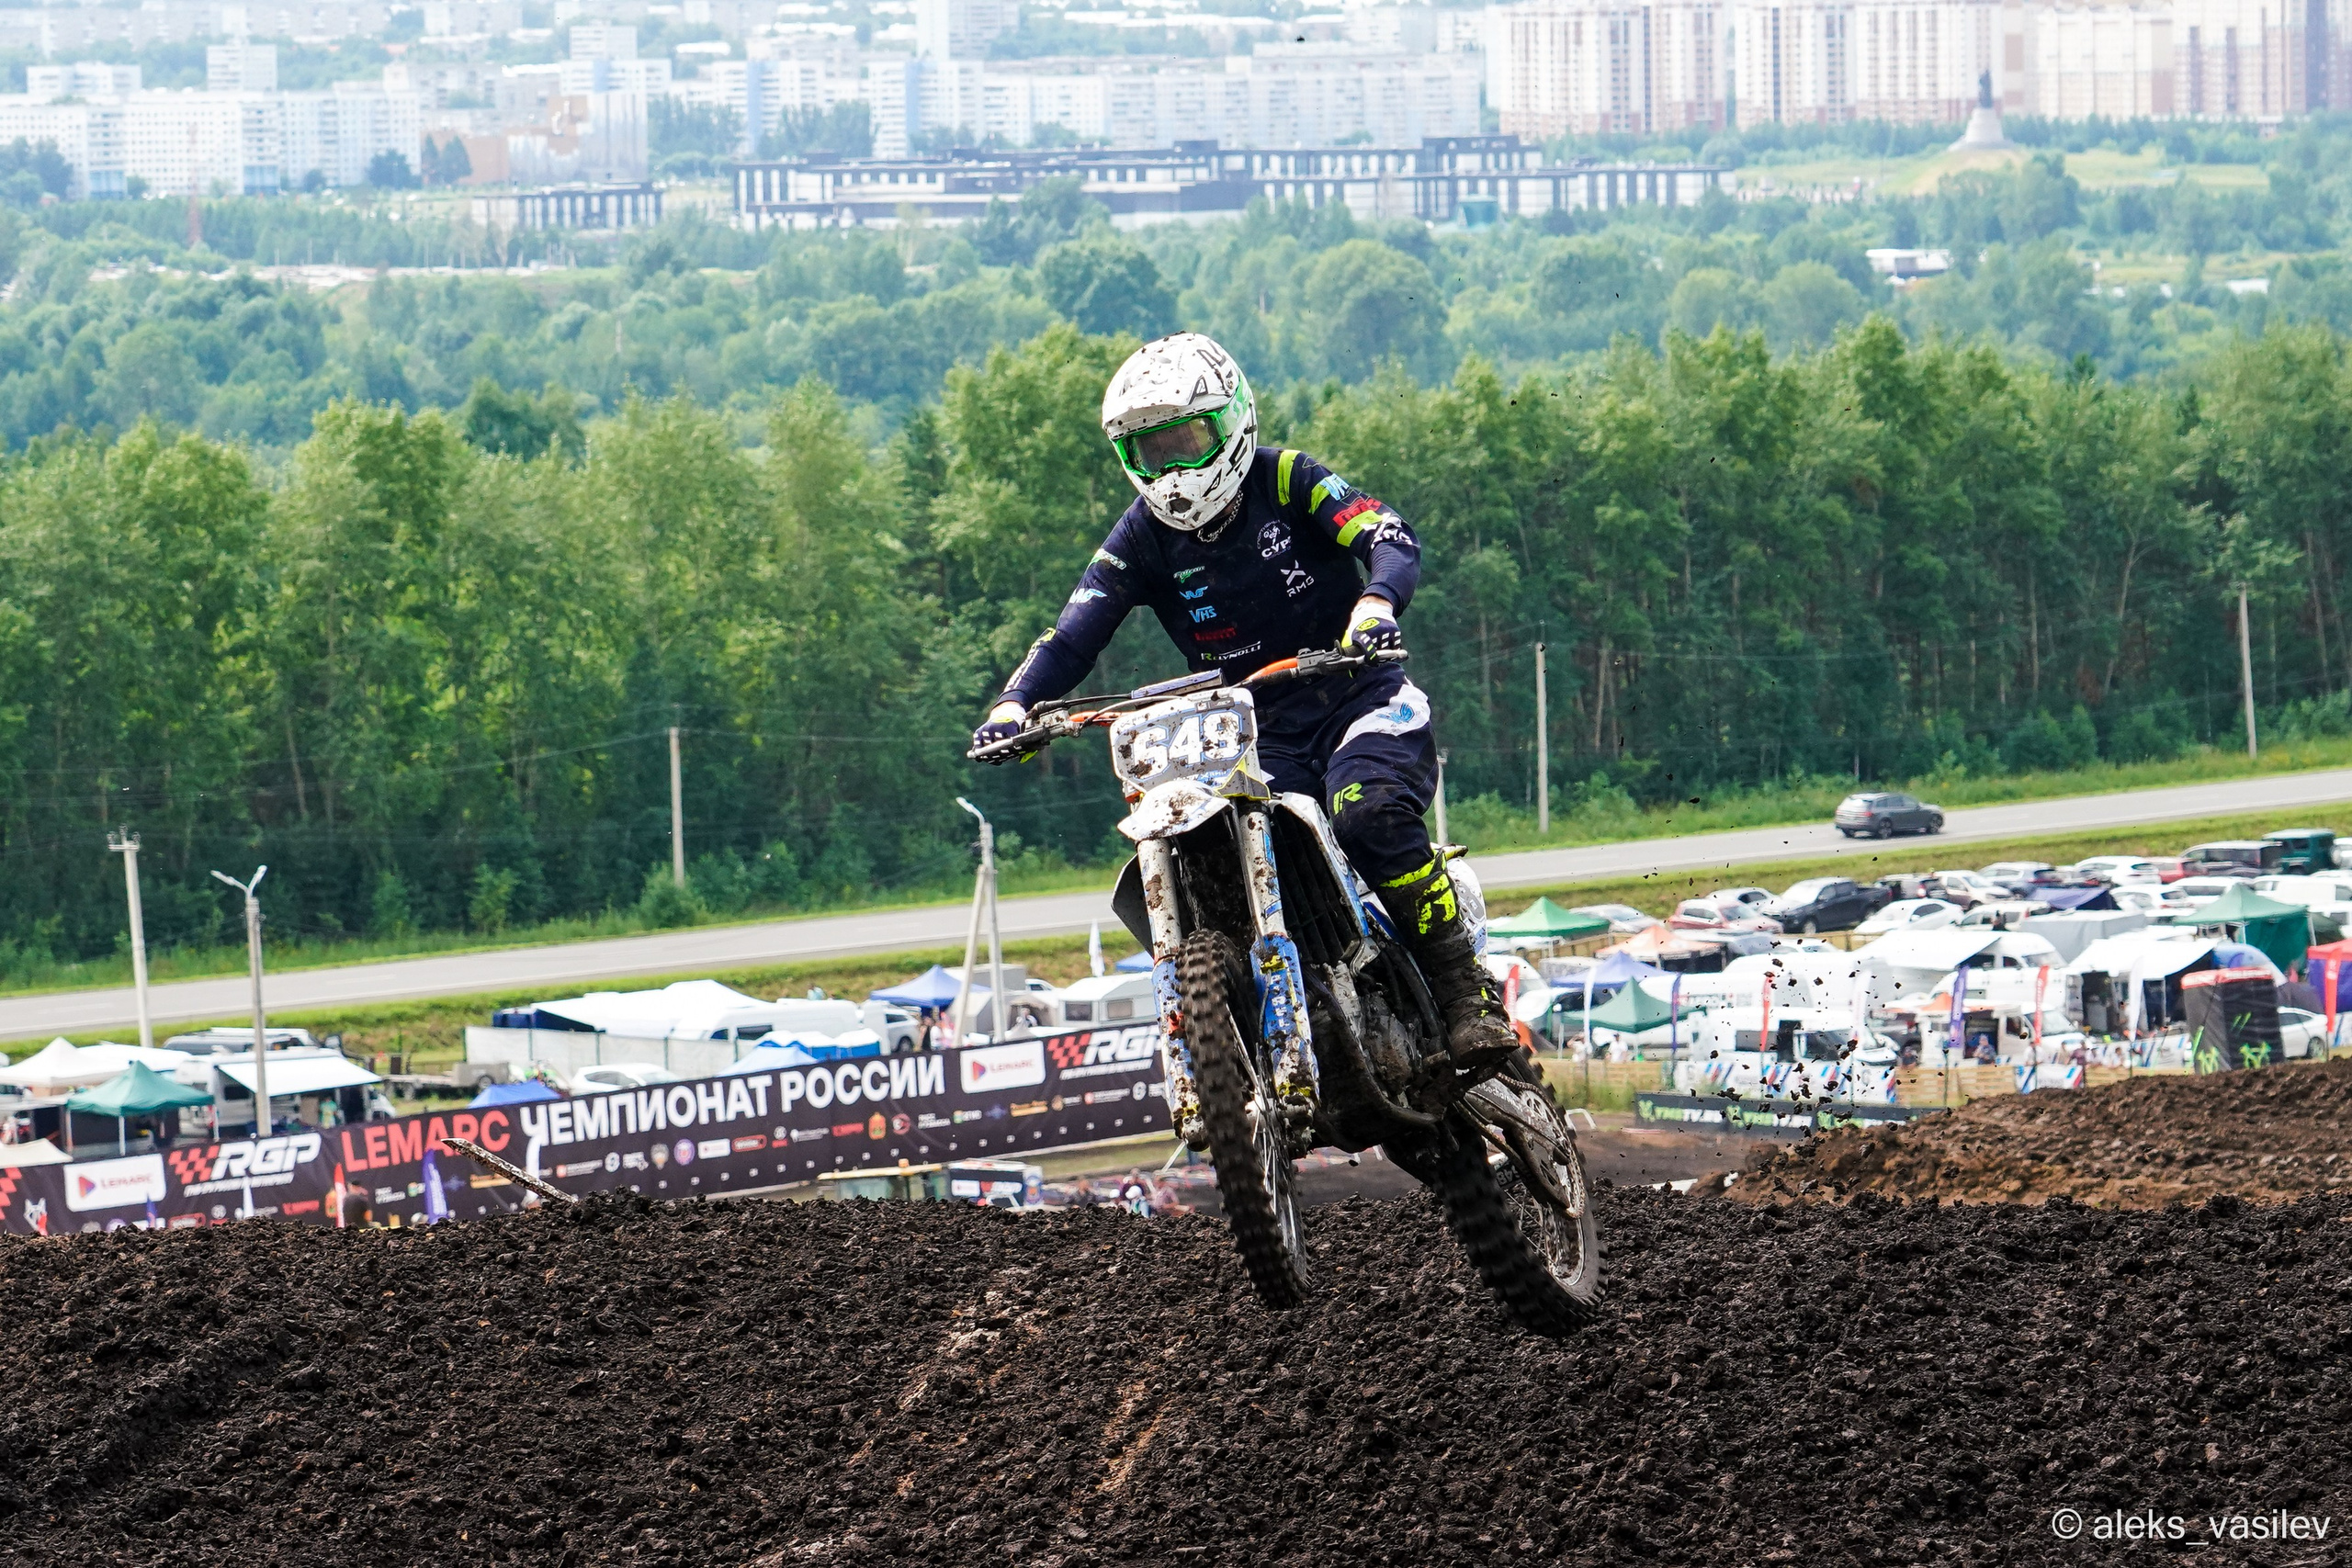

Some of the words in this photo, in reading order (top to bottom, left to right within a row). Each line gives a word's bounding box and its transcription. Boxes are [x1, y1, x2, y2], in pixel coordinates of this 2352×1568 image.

[1286, 575, 1315, 598] RMG
[1188, 605, 1217, 623] VHS
[1133, 710, 1241, 781] 648
[519, 1074, 773, 1147] ЧЕМПИОНАТ
[780, 1054, 946, 1113] РОССИИ
[209, 1132, 322, 1181] RGP
